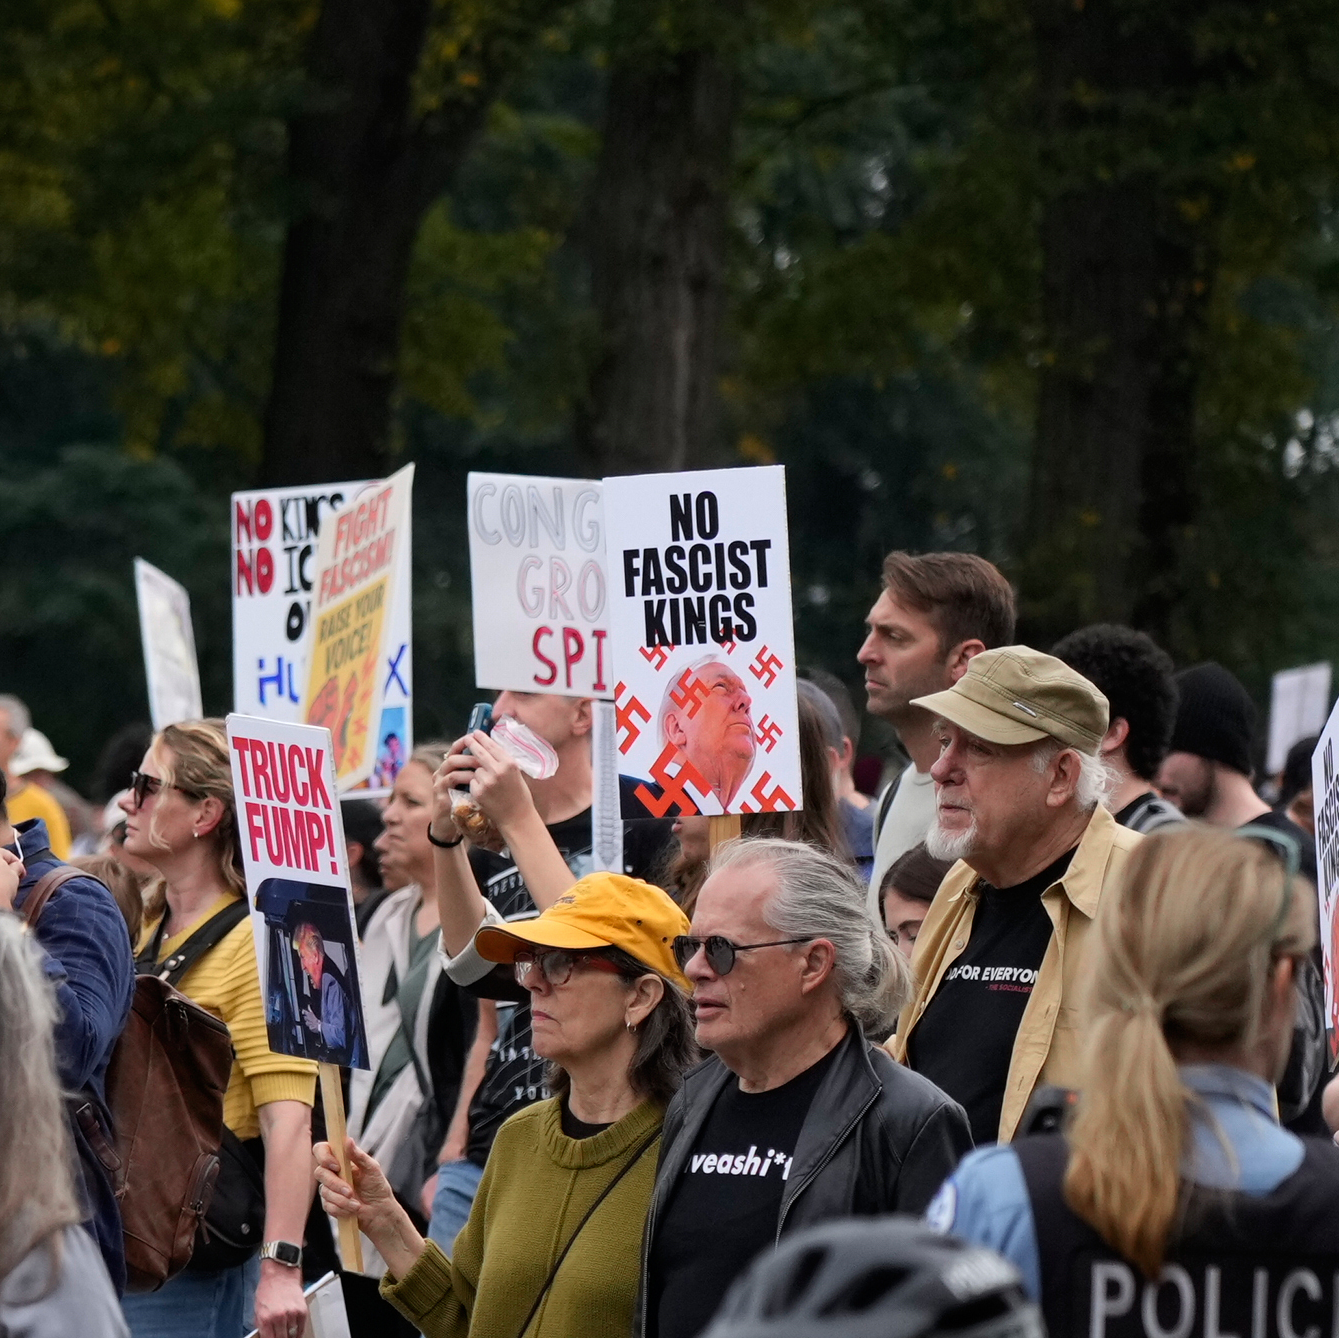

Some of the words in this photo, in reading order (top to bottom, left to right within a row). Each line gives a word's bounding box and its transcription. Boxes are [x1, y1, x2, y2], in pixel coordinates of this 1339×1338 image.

[235, 498, 274, 545] NO
[333, 487, 394, 559] FIGHT
[669, 491, 720, 542] NO
[235, 546, 274, 598] NO
[622, 539, 773, 597] FASCIST
[643, 592, 758, 648] KINGS
[231, 735, 333, 811] TRUCK
[245, 801, 339, 876] FUMP!
